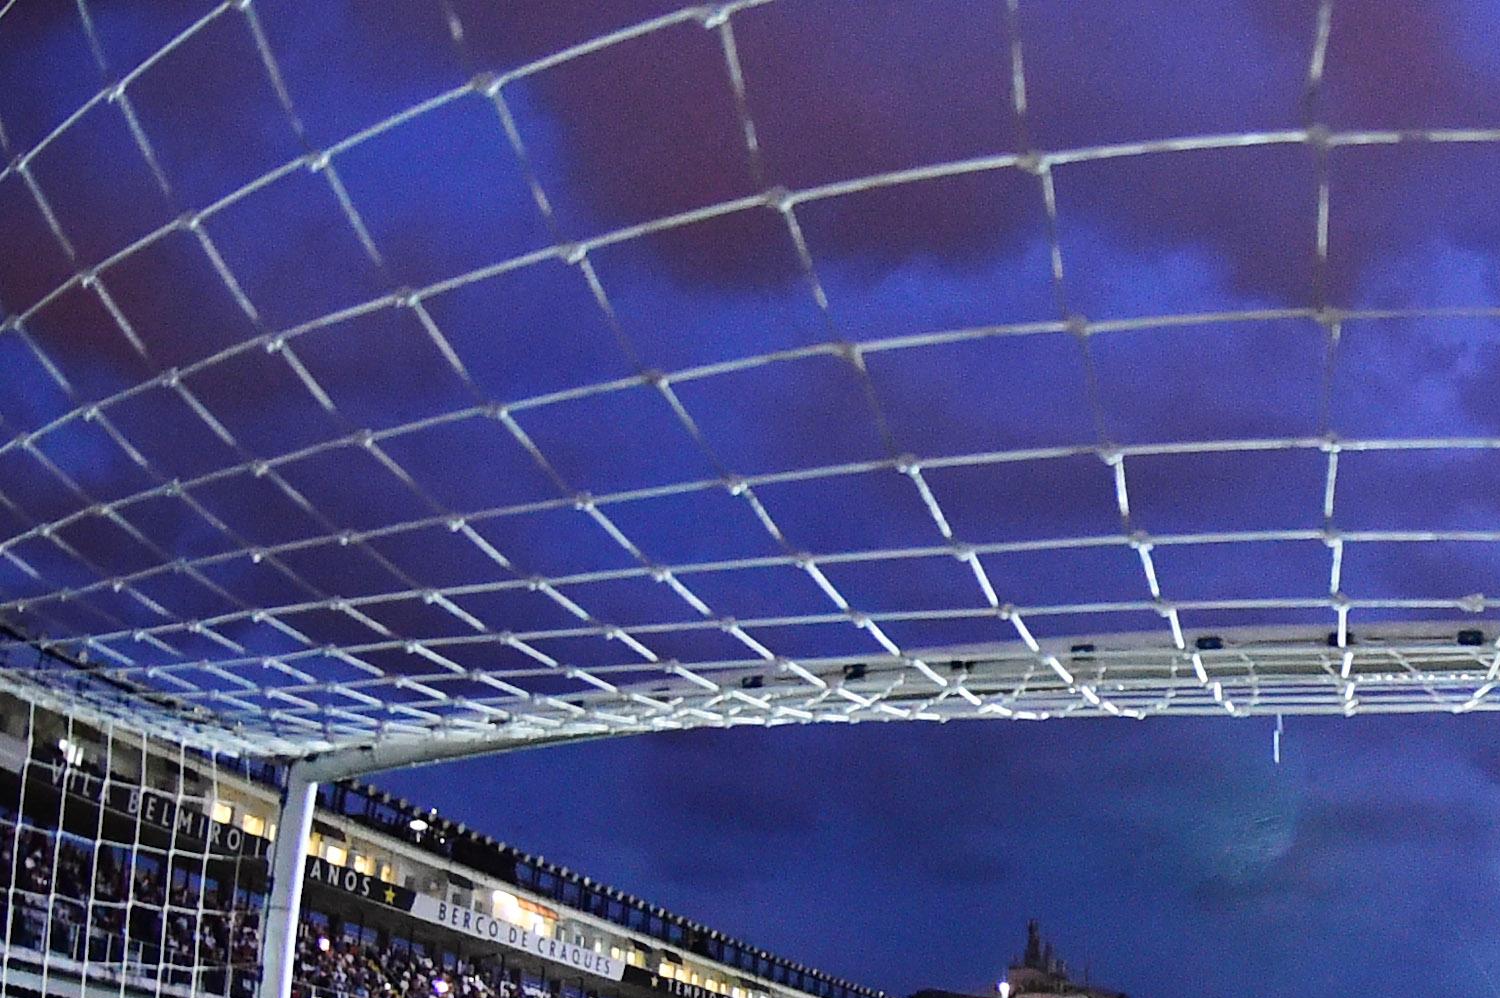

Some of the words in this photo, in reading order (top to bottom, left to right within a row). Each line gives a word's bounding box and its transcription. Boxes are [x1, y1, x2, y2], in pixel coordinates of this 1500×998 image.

[52, 758, 110, 805] VILA
[128, 789, 240, 850] BELMIRO
[309, 863, 371, 897] ANOS
[509, 927, 528, 947] DE
[537, 937, 610, 975] CRAQUES
